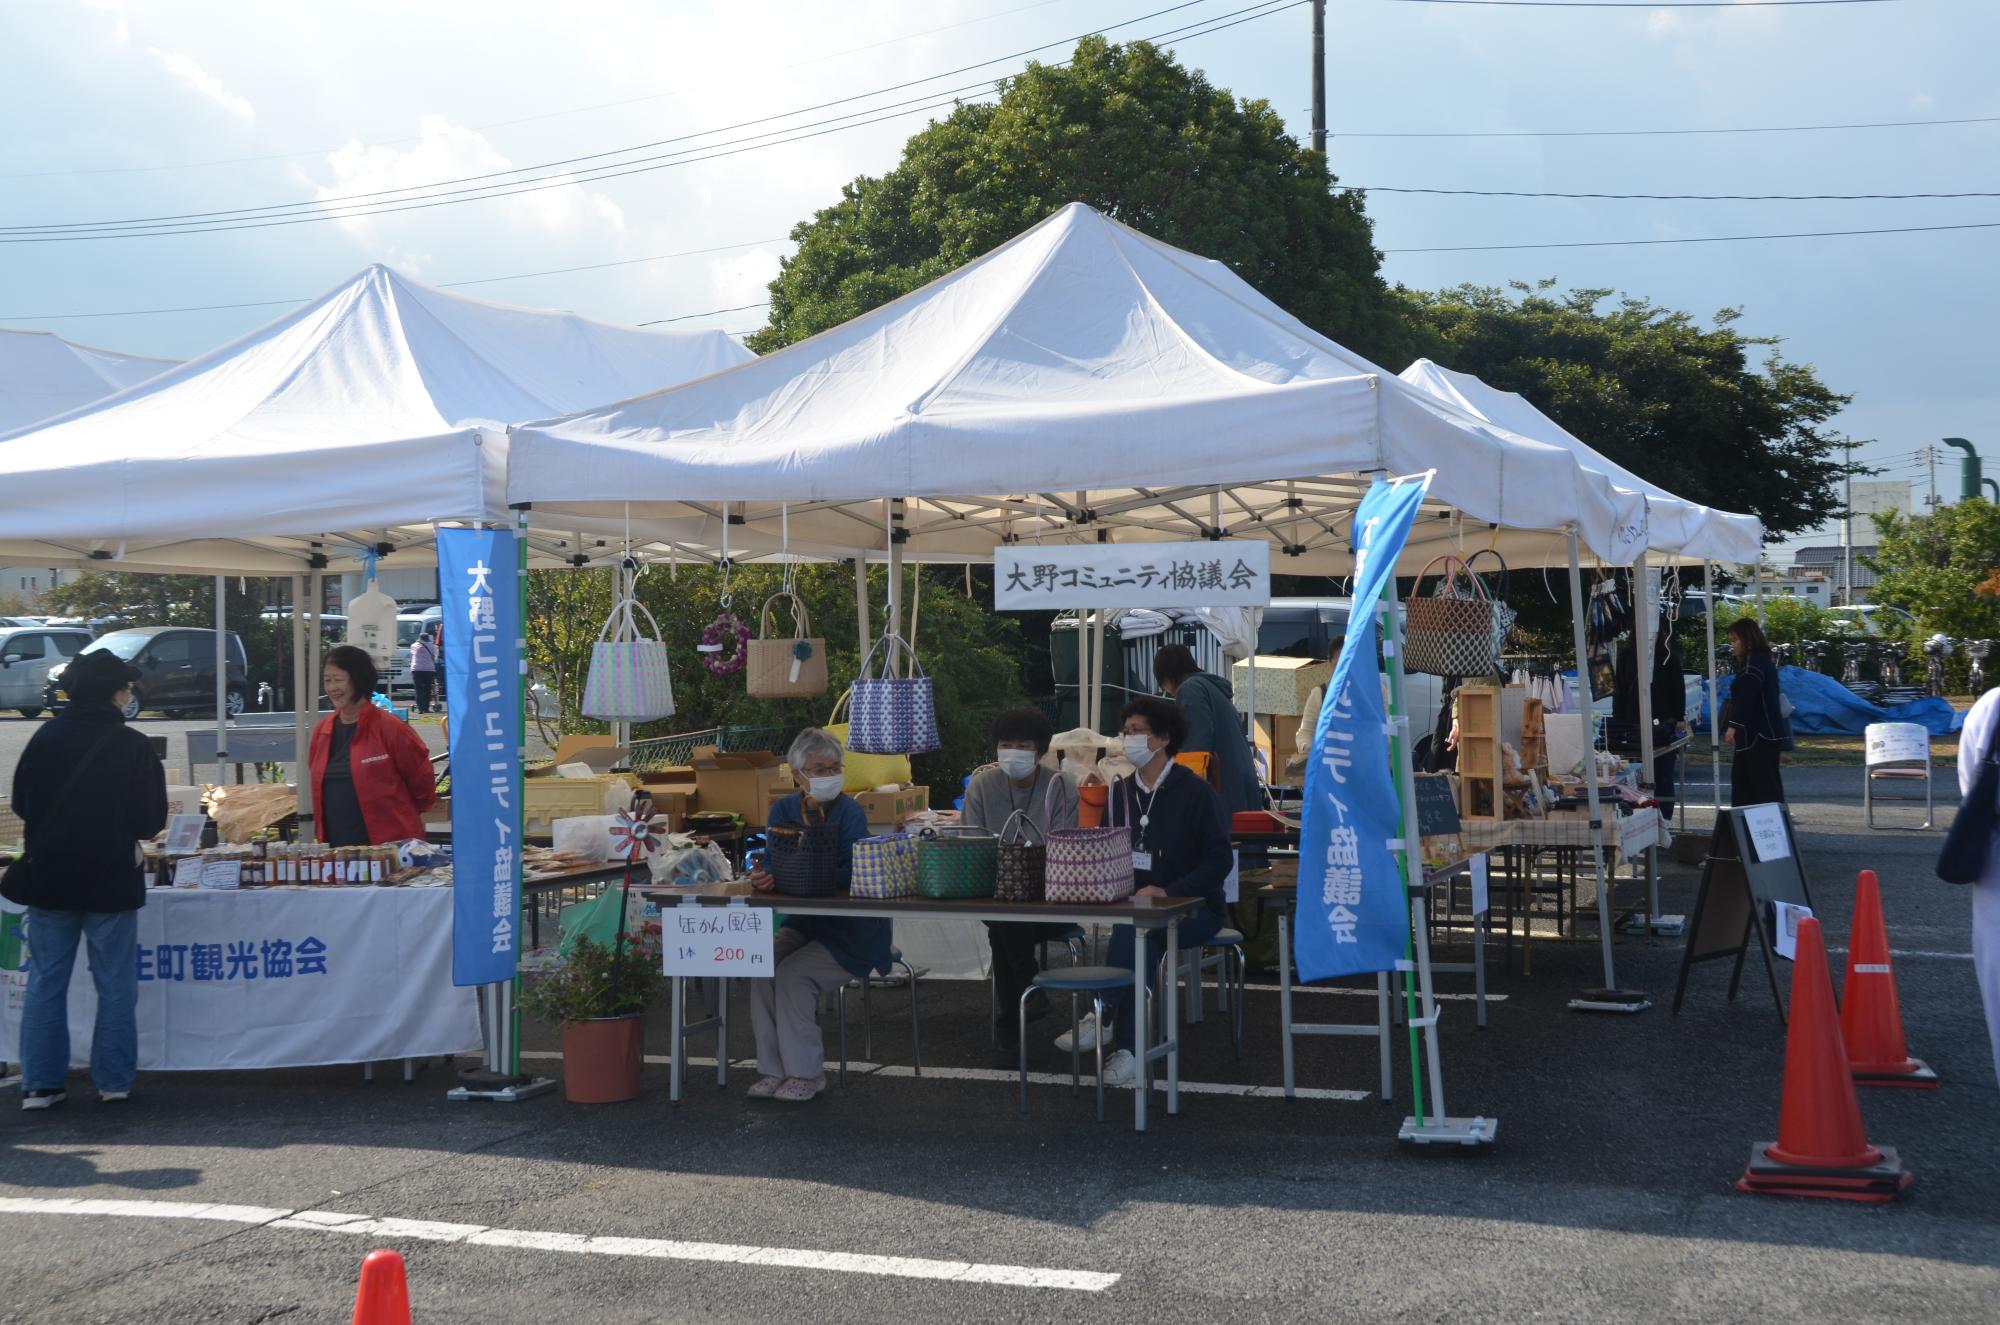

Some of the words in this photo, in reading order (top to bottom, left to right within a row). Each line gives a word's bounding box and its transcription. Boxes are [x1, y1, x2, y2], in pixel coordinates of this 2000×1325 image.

[1004, 558, 1259, 592] 大野コミュニティ協議会
